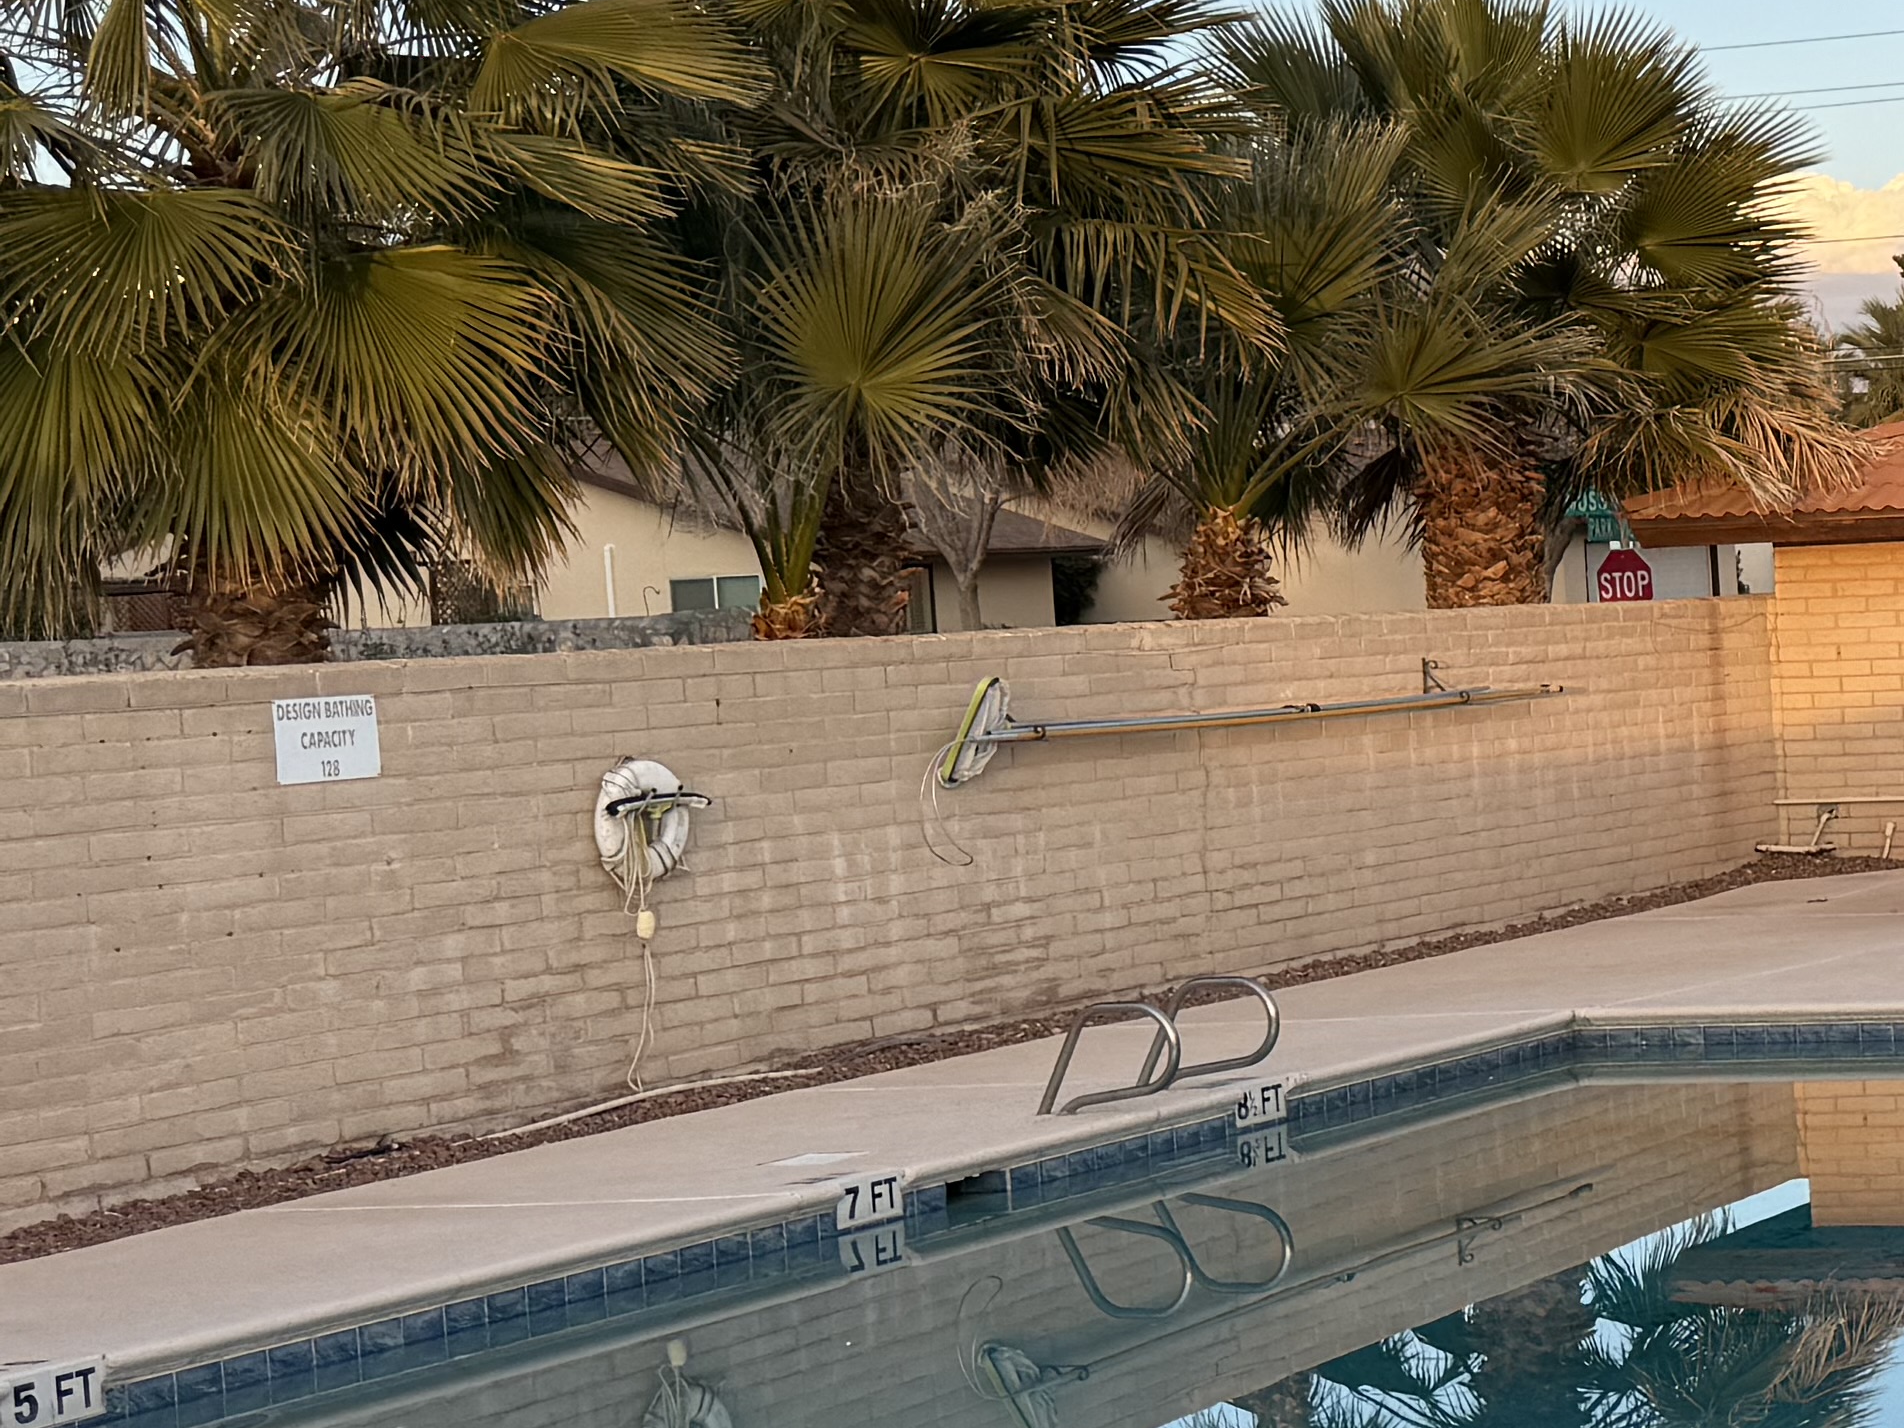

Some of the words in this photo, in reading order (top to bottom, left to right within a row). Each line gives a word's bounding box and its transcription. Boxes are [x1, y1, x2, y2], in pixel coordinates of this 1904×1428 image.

[1601, 570, 1649, 599] STOP
[276, 701, 320, 721] DESIGN
[324, 699, 373, 718] BATHING
[300, 729, 355, 749] CAPACITY
[321, 760, 340, 777] 128
[1261, 1083, 1282, 1115] FT
[844, 1185, 859, 1219] 7
[871, 1176, 897, 1213] FT
[13, 1382, 39, 1424] 5
[55, 1366, 96, 1415] FT
